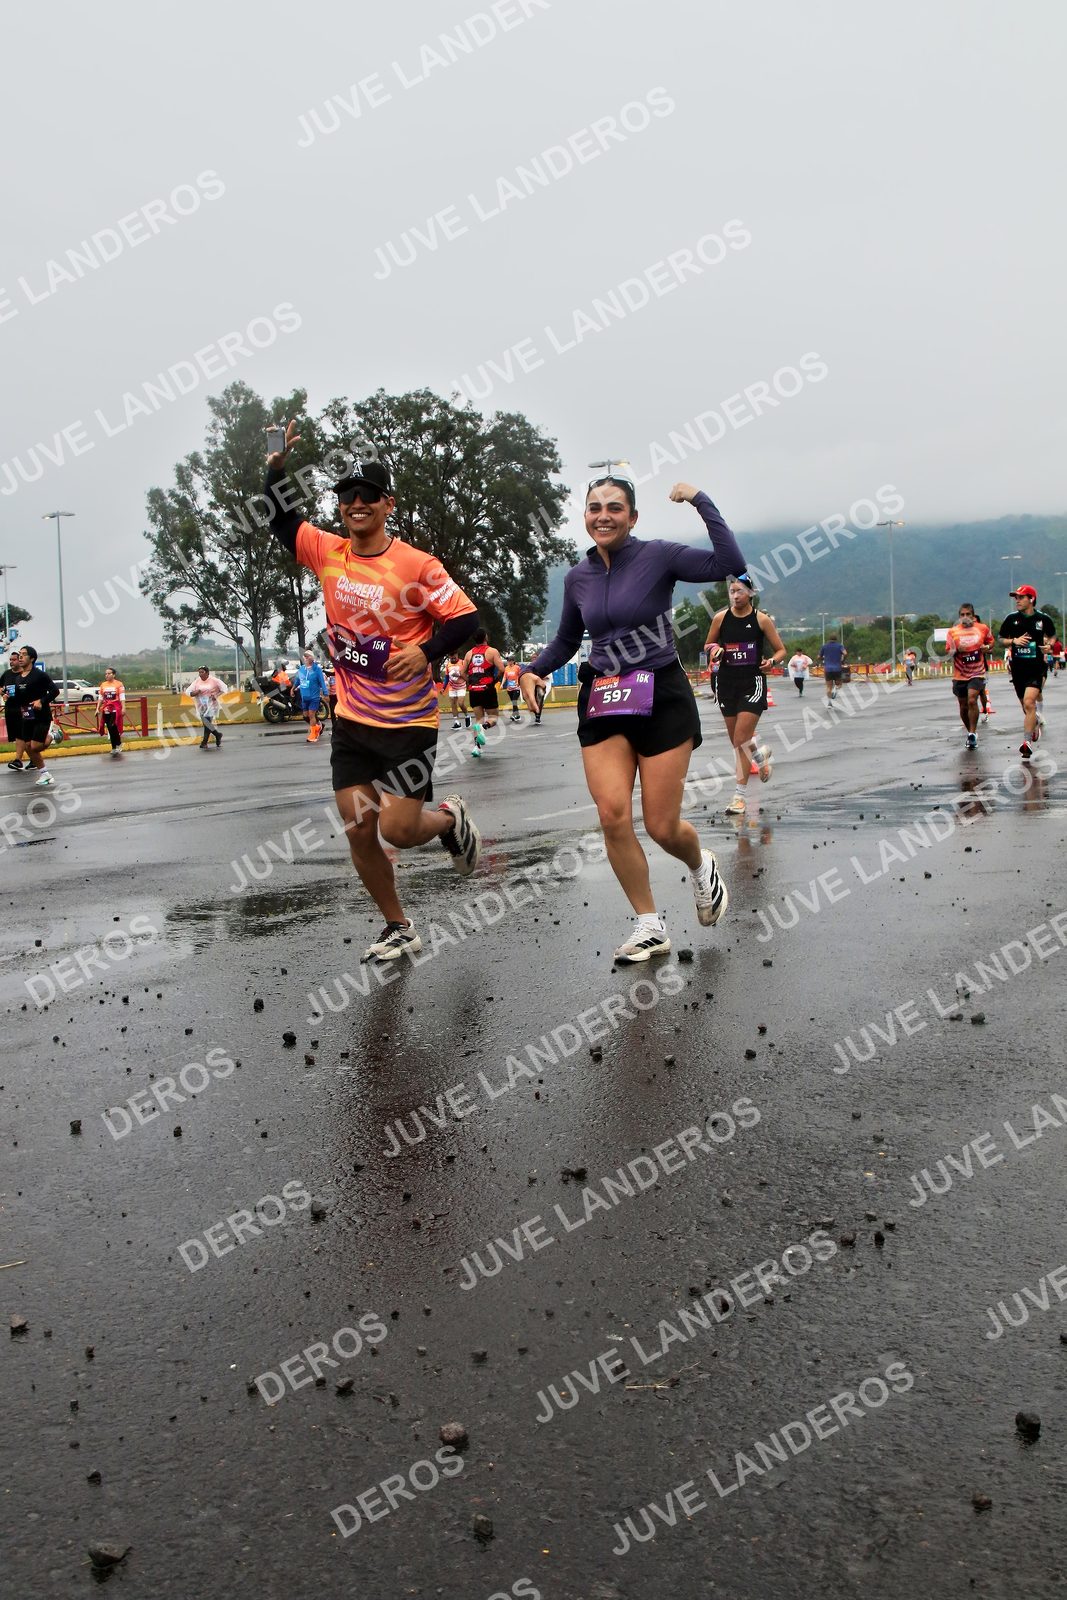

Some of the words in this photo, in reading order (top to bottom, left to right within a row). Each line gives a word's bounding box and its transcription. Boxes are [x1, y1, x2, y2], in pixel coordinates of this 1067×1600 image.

[337, 575, 385, 600] CARRERA
[335, 590, 368, 609] OMNILIFE
[372, 640, 387, 651] 16K
[345, 647, 369, 667] 596
[732, 651, 747, 660] 151
[636, 673, 650, 684] 16K
[602, 688, 632, 704] 597
